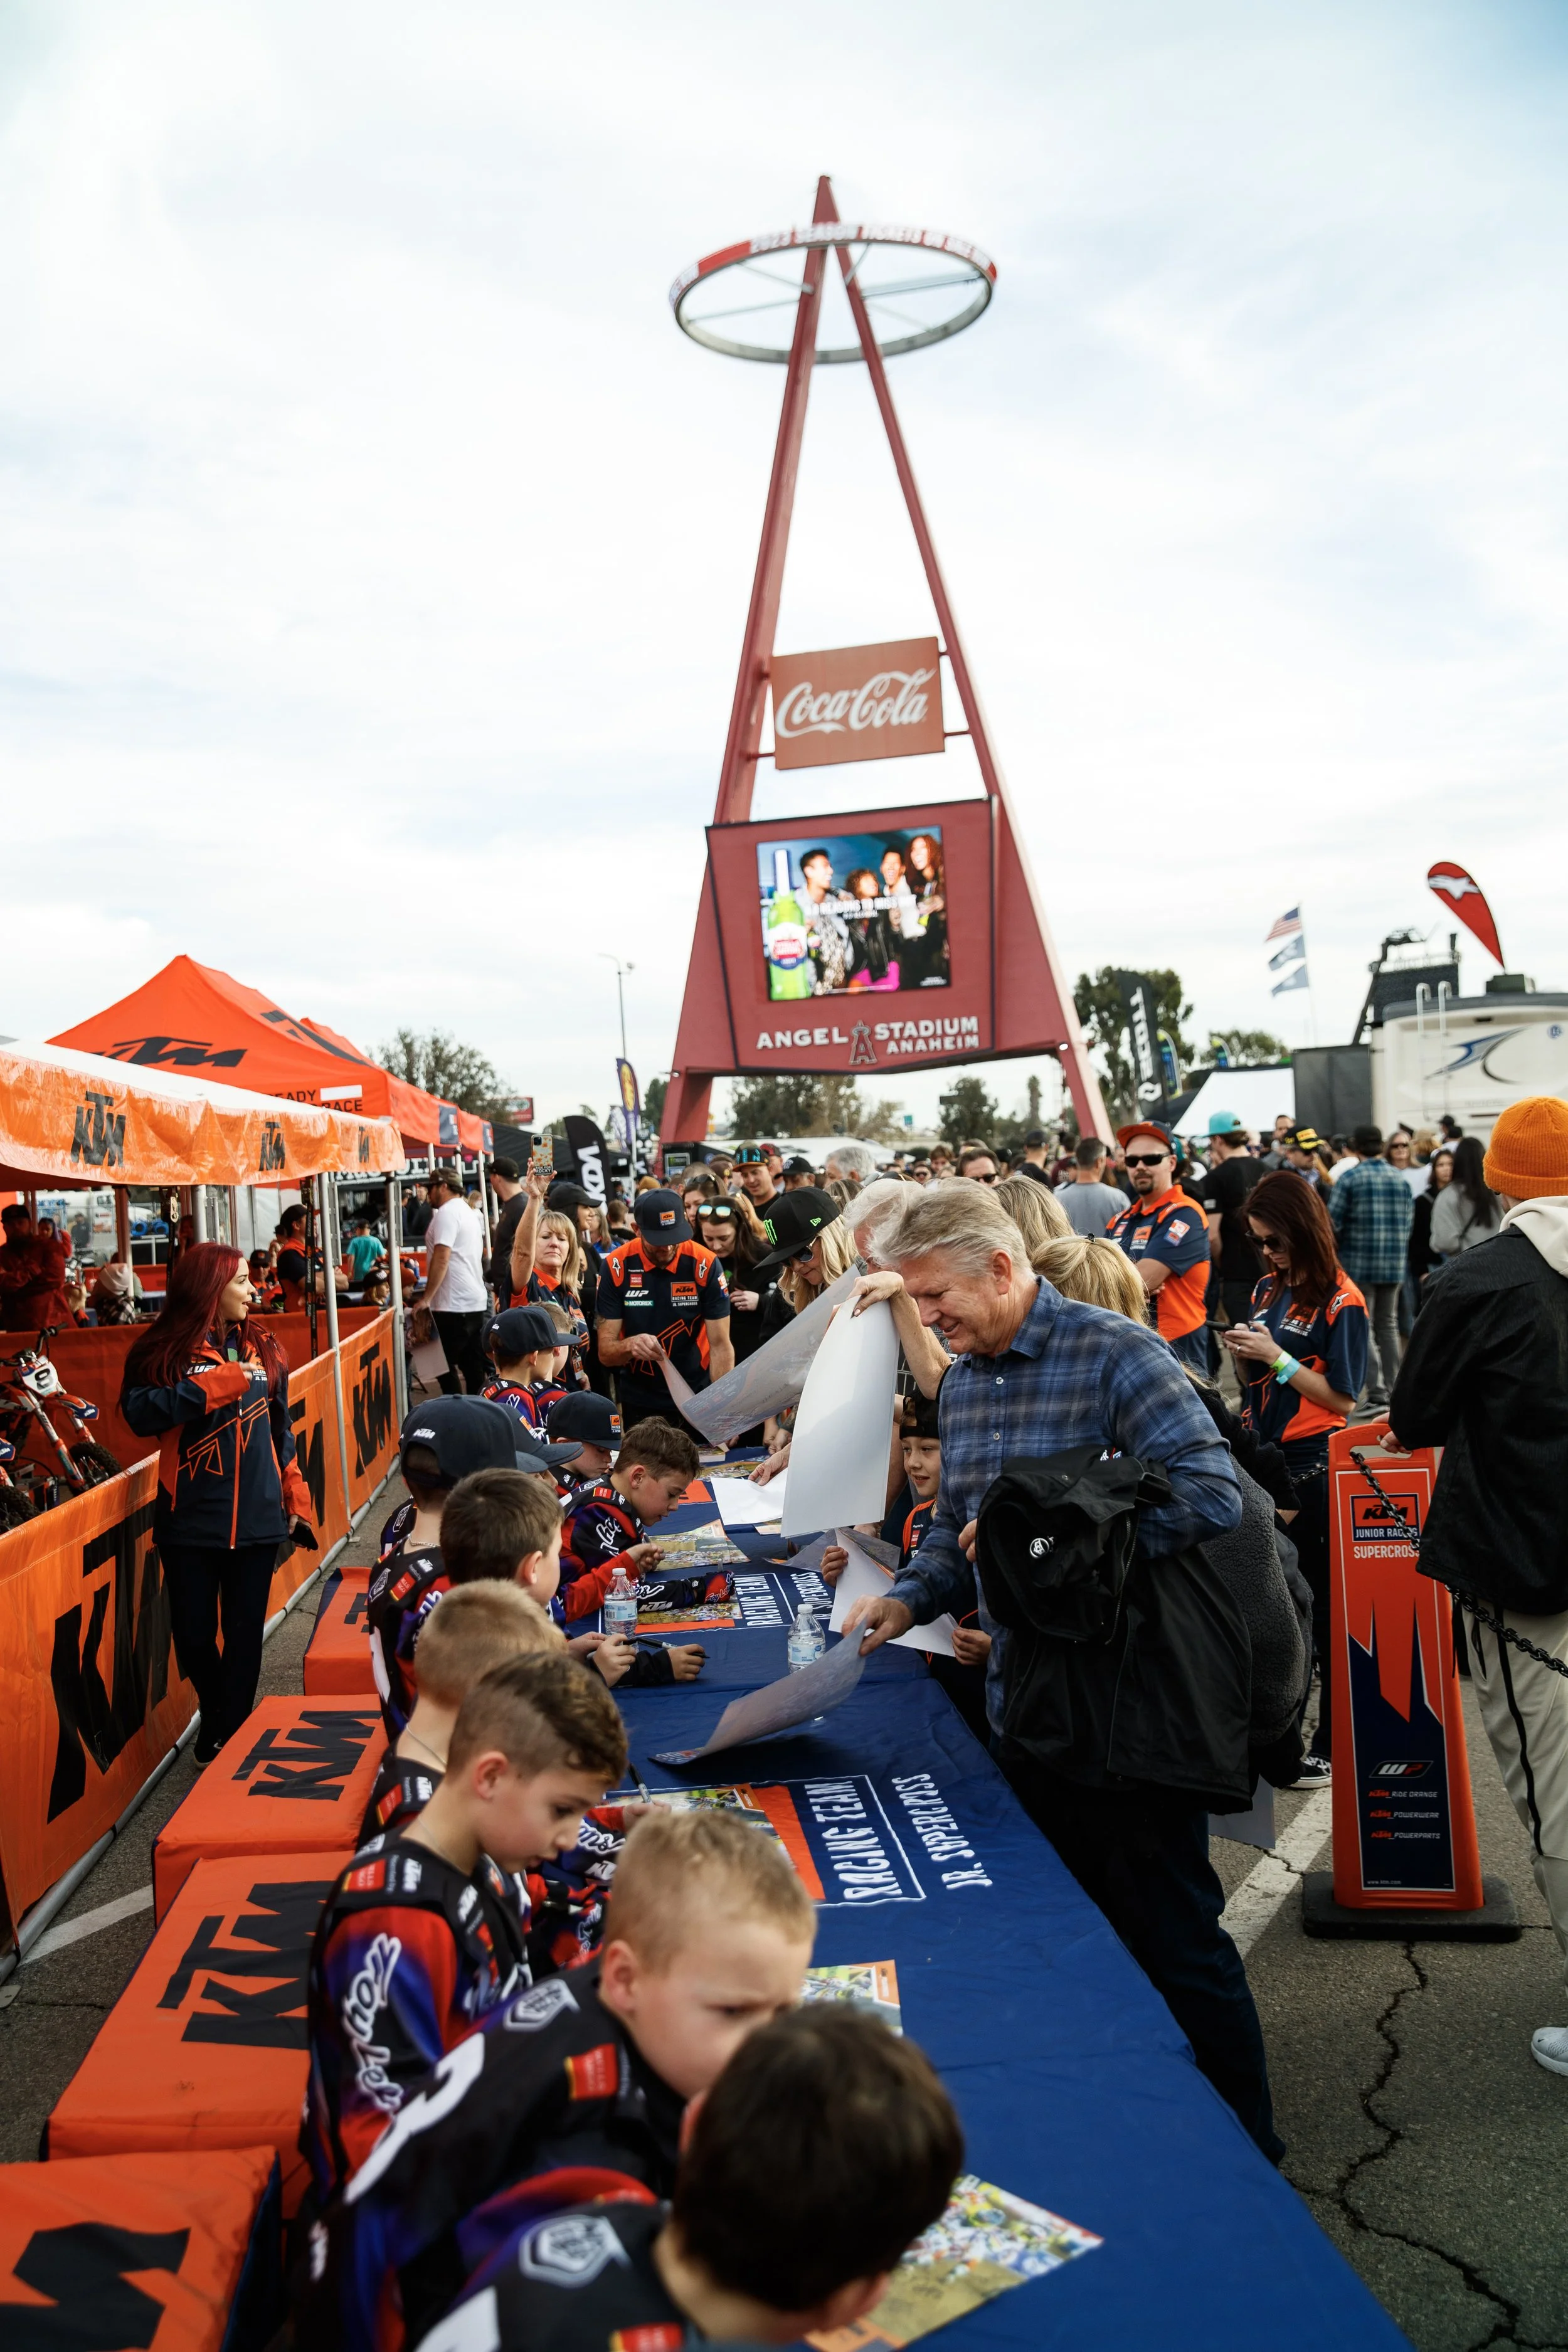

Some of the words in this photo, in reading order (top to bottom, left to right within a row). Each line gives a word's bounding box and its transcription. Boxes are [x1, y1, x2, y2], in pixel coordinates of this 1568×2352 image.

[756, 1026, 849, 1049] ANGEL
[874, 1015, 979, 1041] STADIUM
[886, 1034, 980, 1055] ANAHEIM
[70, 1090, 126, 1168] KTM
[258, 1121, 286, 1172] KTM
[625, 1290, 649, 1298] WP
[352, 1341, 392, 1479] KTM
[413, 1428, 436, 1439] KTM
[1355, 1528, 1385, 1539] JUNIOR
[733, 1576, 771, 1595] TEAM
[639, 1601, 673, 1613] KTM
[739, 1595, 783, 1626] RACING
[231, 1710, 383, 1802] KTM
[1378, 1764, 1424, 1775] WP
[804, 1781, 867, 1823] TEAM
[891, 1773, 975, 1862] SUPERCROSS
[585, 1860, 618, 1881] KT
[822, 1826, 903, 1900] RACING
[941, 1862, 993, 1890] JR.
